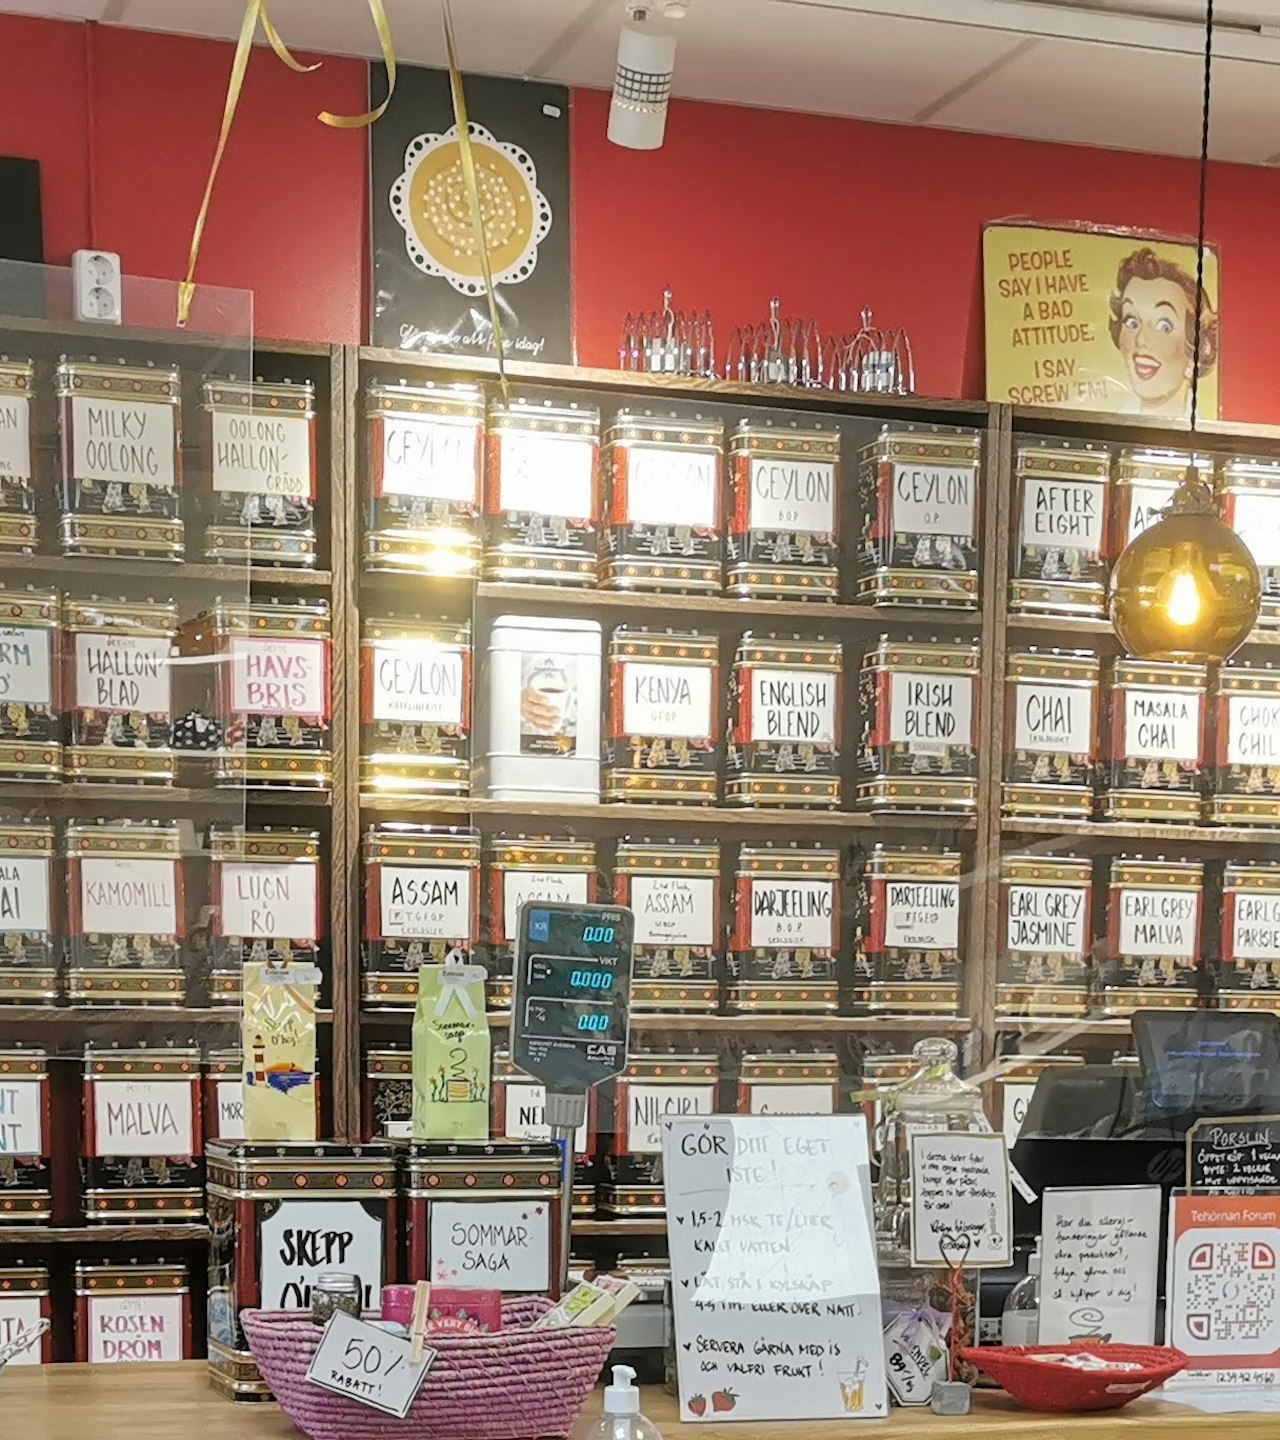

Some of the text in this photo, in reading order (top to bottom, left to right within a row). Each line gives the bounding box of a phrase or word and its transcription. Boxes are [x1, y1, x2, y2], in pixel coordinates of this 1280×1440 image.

[1008, 250, 1073, 272] PEOPLE
[999, 274, 1089, 298] SAY I HAVE
[1023, 300, 1072, 321] A BAD
[1012, 324, 1095, 348] ATTITUDE.
[1035, 358, 1076, 378] I SAY
[88, 408, 146, 440] MILKY
[229, 418, 286, 442] OOLONG
[86, 441, 158, 476] OOLONG
[755, 464, 831, 502] CEYLON
[898, 464, 970, 507] CEYLON
[1035, 485, 1095, 514] AFTER
[1035, 511, 1096, 538] EIGHT
[96, 673, 141, 707] BLAD
[246, 680, 306, 708] BRIS
[634, 674, 692, 706] KENYA
[760, 680, 827, 707] ENGLISH
[906, 680, 953, 707] IRISH
[1025, 693, 1073, 734] CHAI
[1133, 699, 1188, 720] MASALA
[767, 710, 820, 738] BLEND
[905, 710, 956, 738] BLEND
[84, 881, 171, 909] KAMOMILL
[238, 872, 291, 903] LUGN
[392, 877, 459, 907] ASSAM
[644, 894, 695, 915] ASSAM
[754, 887, 831, 919] DARJEELING
[250, 908, 275, 935] RO
[535, 922, 547, 930] KR
[1011, 919, 1078, 947] JASMINE
[1134, 922, 1184, 946] MALVA
[600, 956, 618, 965] VKT
[587, 1044, 616, 1056] CAS
[107, 1102, 179, 1136] MALVA
[681, 1123, 729, 1156] GÖR
[783, 1137, 831, 1156] EGET
[1243, 1210, 1276, 1222] Forum
[279, 1229, 354, 1267] SKEPP
[462, 1251, 511, 1273] SAGA
[102, 1336, 162, 1360] DRÖM
[341, 1337, 407, 1377] 50%
[700, 1360, 812, 1376] OCH VALFRI FRUKT
